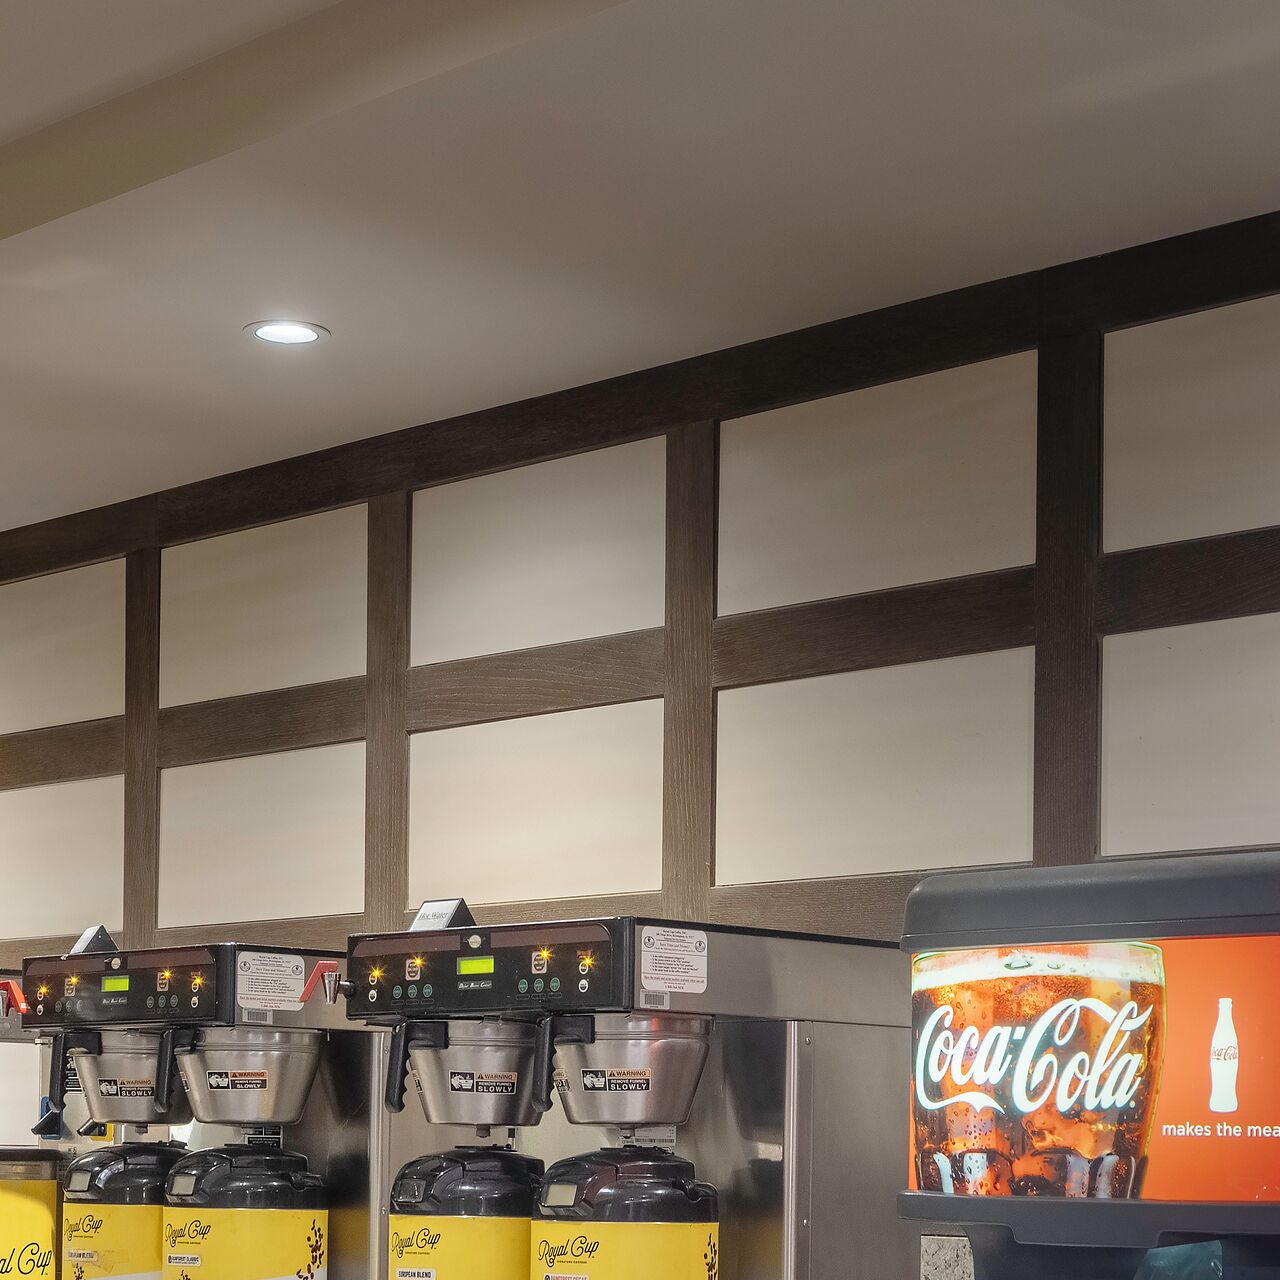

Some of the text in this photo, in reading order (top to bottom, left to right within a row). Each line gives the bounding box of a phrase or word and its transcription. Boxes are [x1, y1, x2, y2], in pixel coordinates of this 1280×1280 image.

[915, 997, 1154, 1115] Coca-Cola
[1162, 1122, 1212, 1137] makes
[1216, 1122, 1242, 1137] the
[82, 1214, 103, 1234] Cup
[187, 1219, 211, 1240] Cup
[416, 1228, 441, 1249] Cup
[17, 1242, 52, 1276] Cup
[538, 1235, 599, 1268] Royal Cup
